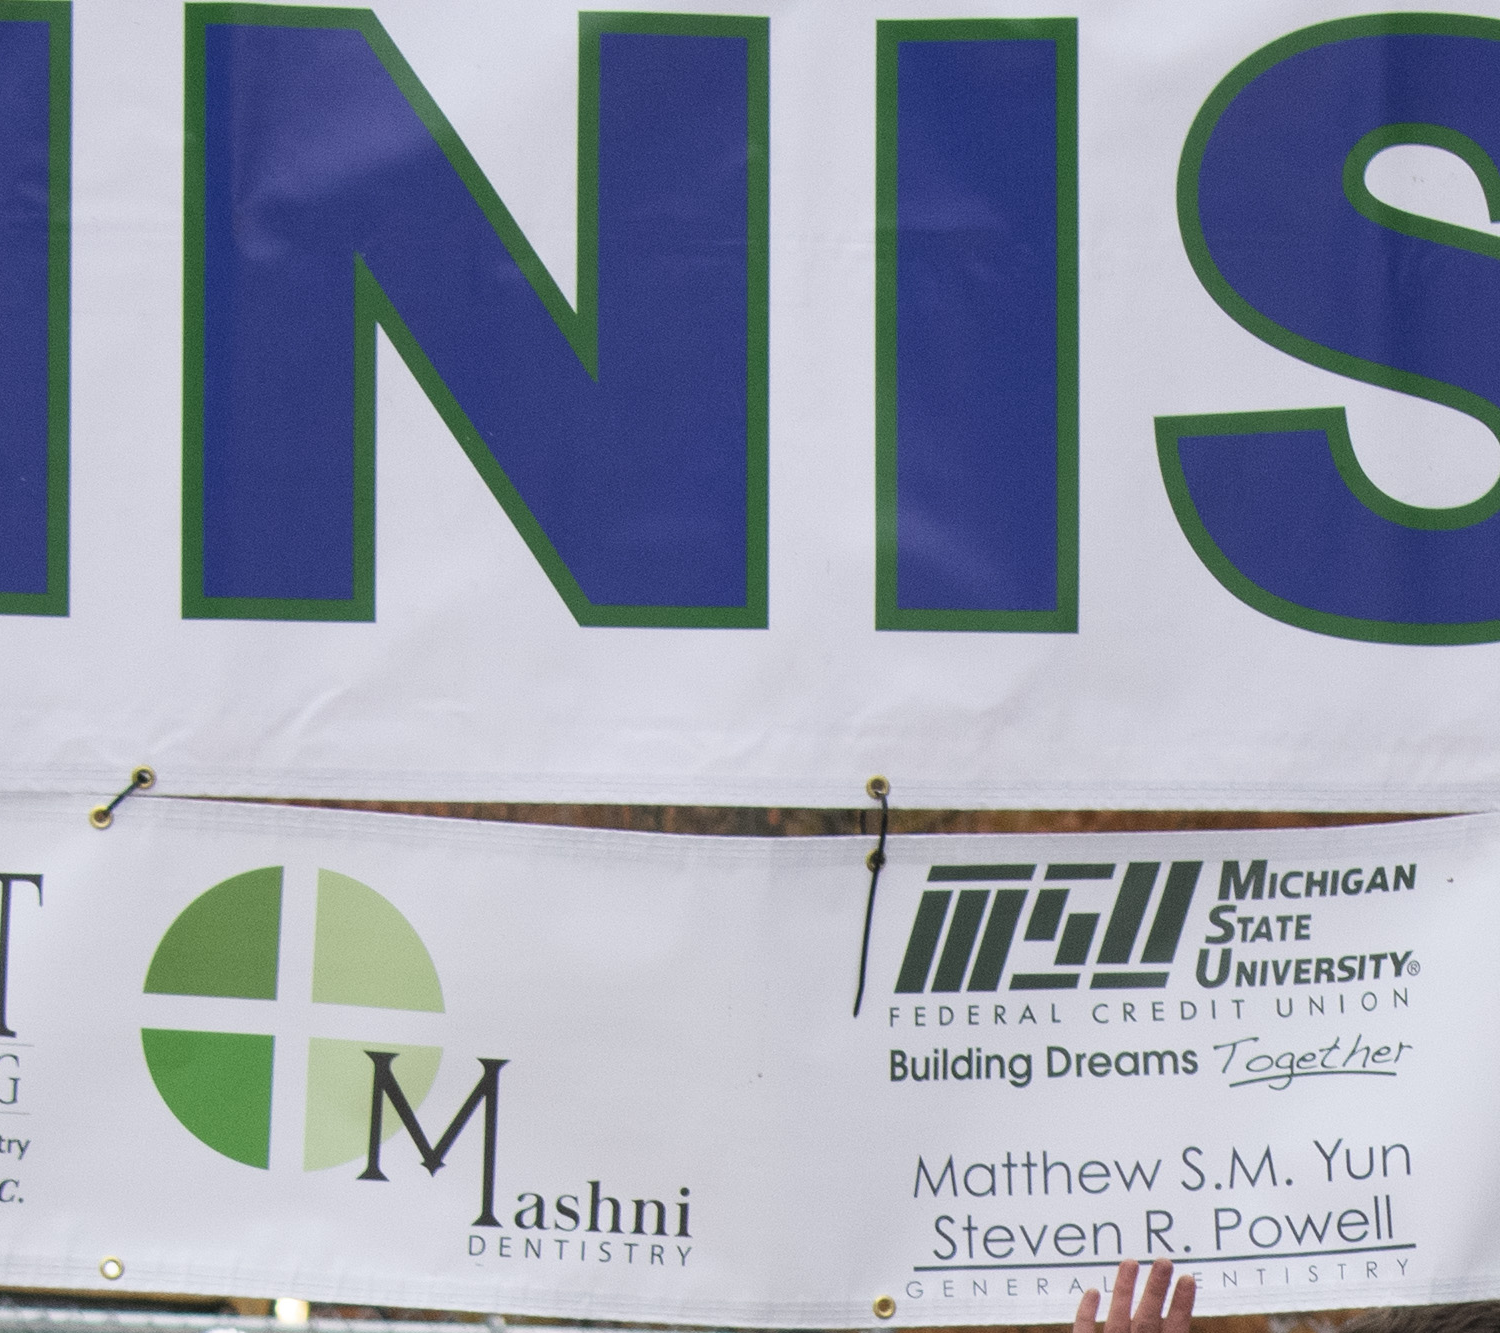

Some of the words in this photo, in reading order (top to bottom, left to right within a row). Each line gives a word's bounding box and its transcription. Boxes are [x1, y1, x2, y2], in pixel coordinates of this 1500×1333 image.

[1218, 859, 1417, 902] MICHIGAN
[1205, 904, 1312, 944] STATE
[890, 1003, 1062, 1028] FEDERAL
[1092, 999, 1246, 1025] CREDIT
[1277, 987, 1409, 1018] UNION
[890, 1046, 1032, 1087] Building
[1047, 1043, 1198, 1078] Dreams
[1214, 1034, 1414, 1090] Together
[356, 1049, 693, 1238] Mashni
[914, 1150, 1162, 1199] Matthew
[1181, 1146, 1293, 1192] S.M.
[1313, 1138, 1412, 1184] Yun
[933, 1214, 1123, 1261] Steven
[1145, 1210, 1192, 1254] R.
[1214, 1195, 1394, 1250] Powell
[467, 1234, 694, 1267] DENTISTRY
[1193, 1259, 1409, 1289] ENTISTRY
